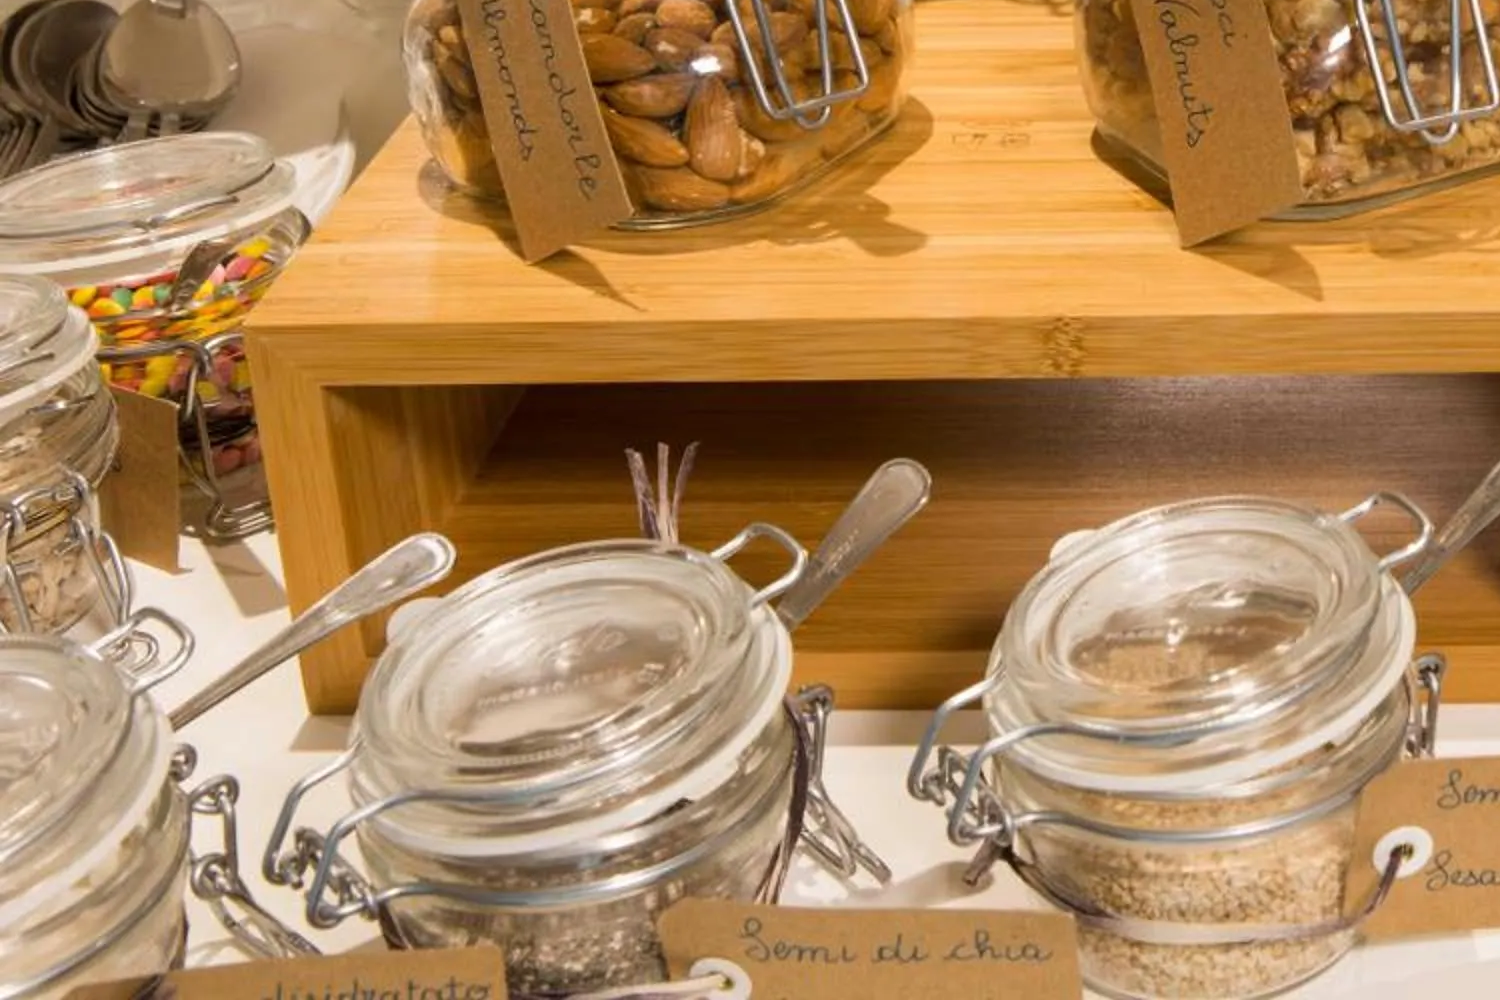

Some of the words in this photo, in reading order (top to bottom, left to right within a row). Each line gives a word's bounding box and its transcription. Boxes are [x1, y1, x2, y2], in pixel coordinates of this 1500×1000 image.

[739, 916, 859, 962] Semi
[870, 932, 930, 963] di
[942, 930, 1053, 964] chia
